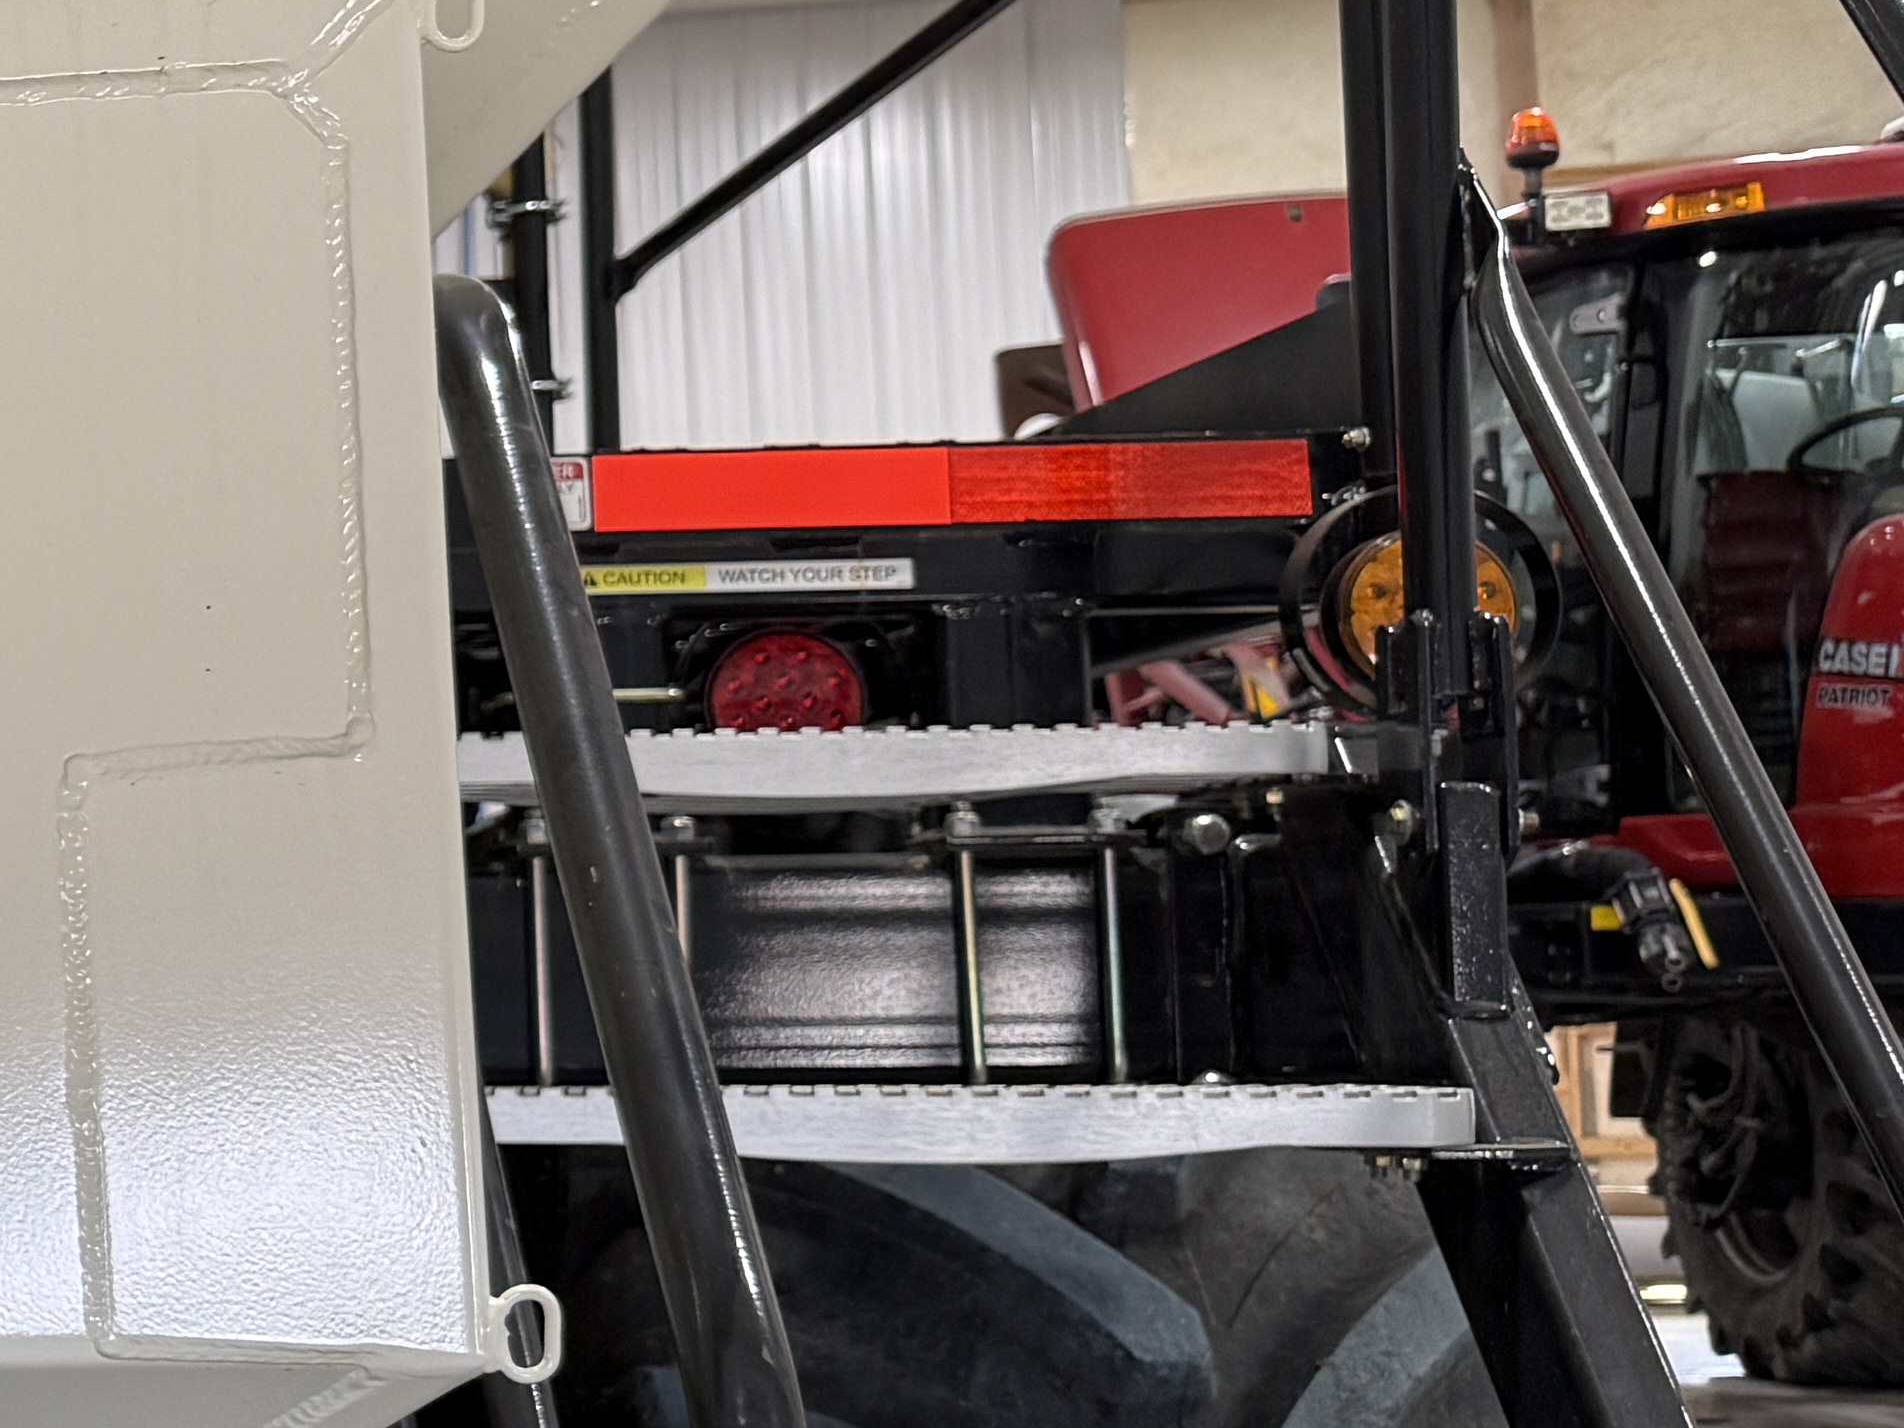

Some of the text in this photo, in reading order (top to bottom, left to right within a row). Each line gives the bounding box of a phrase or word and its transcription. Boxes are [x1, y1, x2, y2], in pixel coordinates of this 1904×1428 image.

[603, 571, 685, 587] CAUTION
[719, 566, 897, 583] WATCH YOUR STEP
[1819, 687, 1890, 707] PATRIOT
